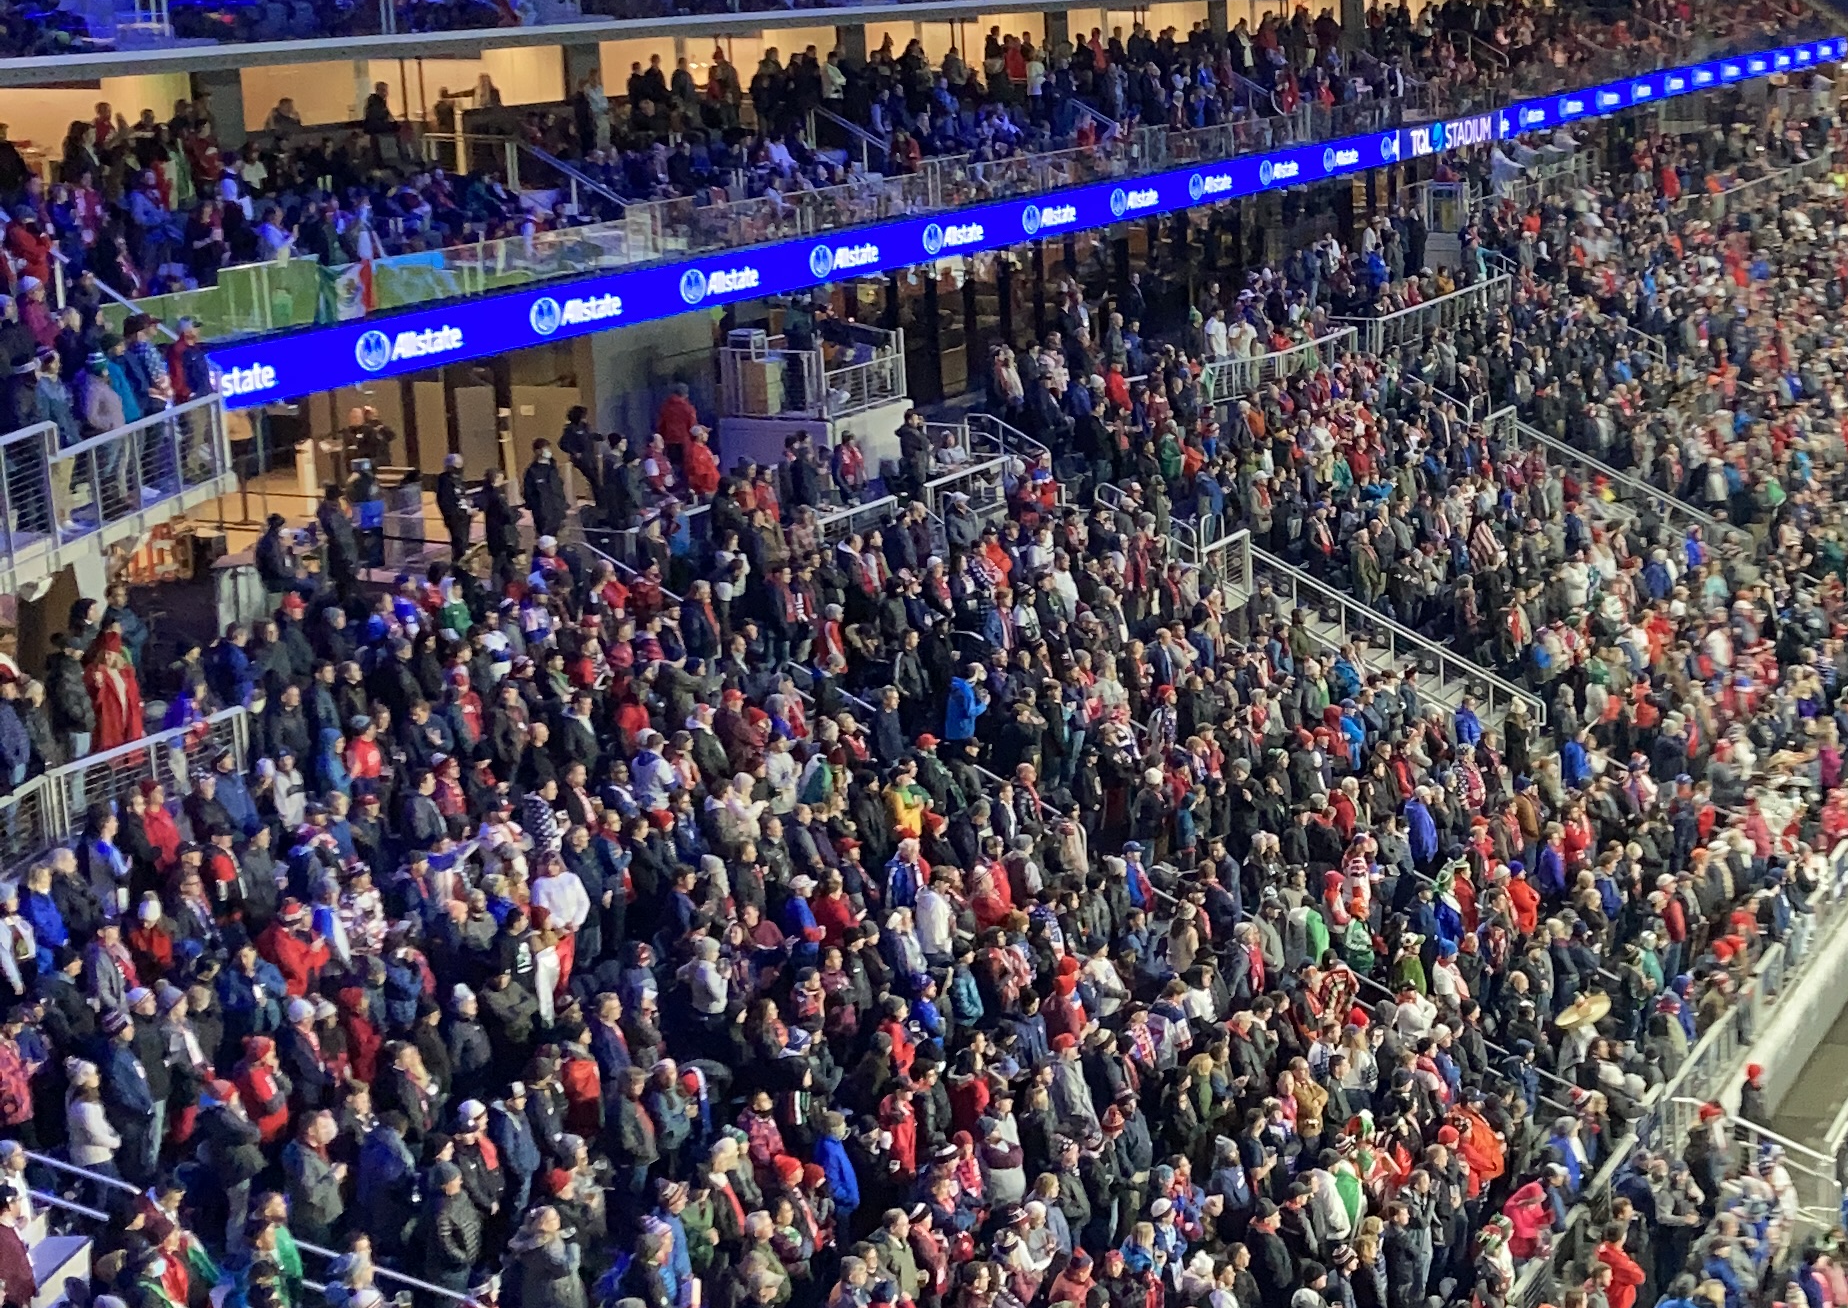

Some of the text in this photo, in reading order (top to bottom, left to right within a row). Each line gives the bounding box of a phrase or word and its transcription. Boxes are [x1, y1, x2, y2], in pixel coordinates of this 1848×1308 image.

[1410, 128, 1433, 156] TQL
[1445, 116, 1492, 144] STADIUM
[1203, 174, 1232, 194] Allstate
[1127, 188, 1159, 210] Allstate
[1040, 205, 1077, 228] Allstate
[942, 223, 984, 248] Allstate
[832, 243, 880, 270] Allstate
[706, 266, 760, 296] Allstate
[561, 293, 622, 326] Allstate
[391, 325, 463, 361] Allstate
